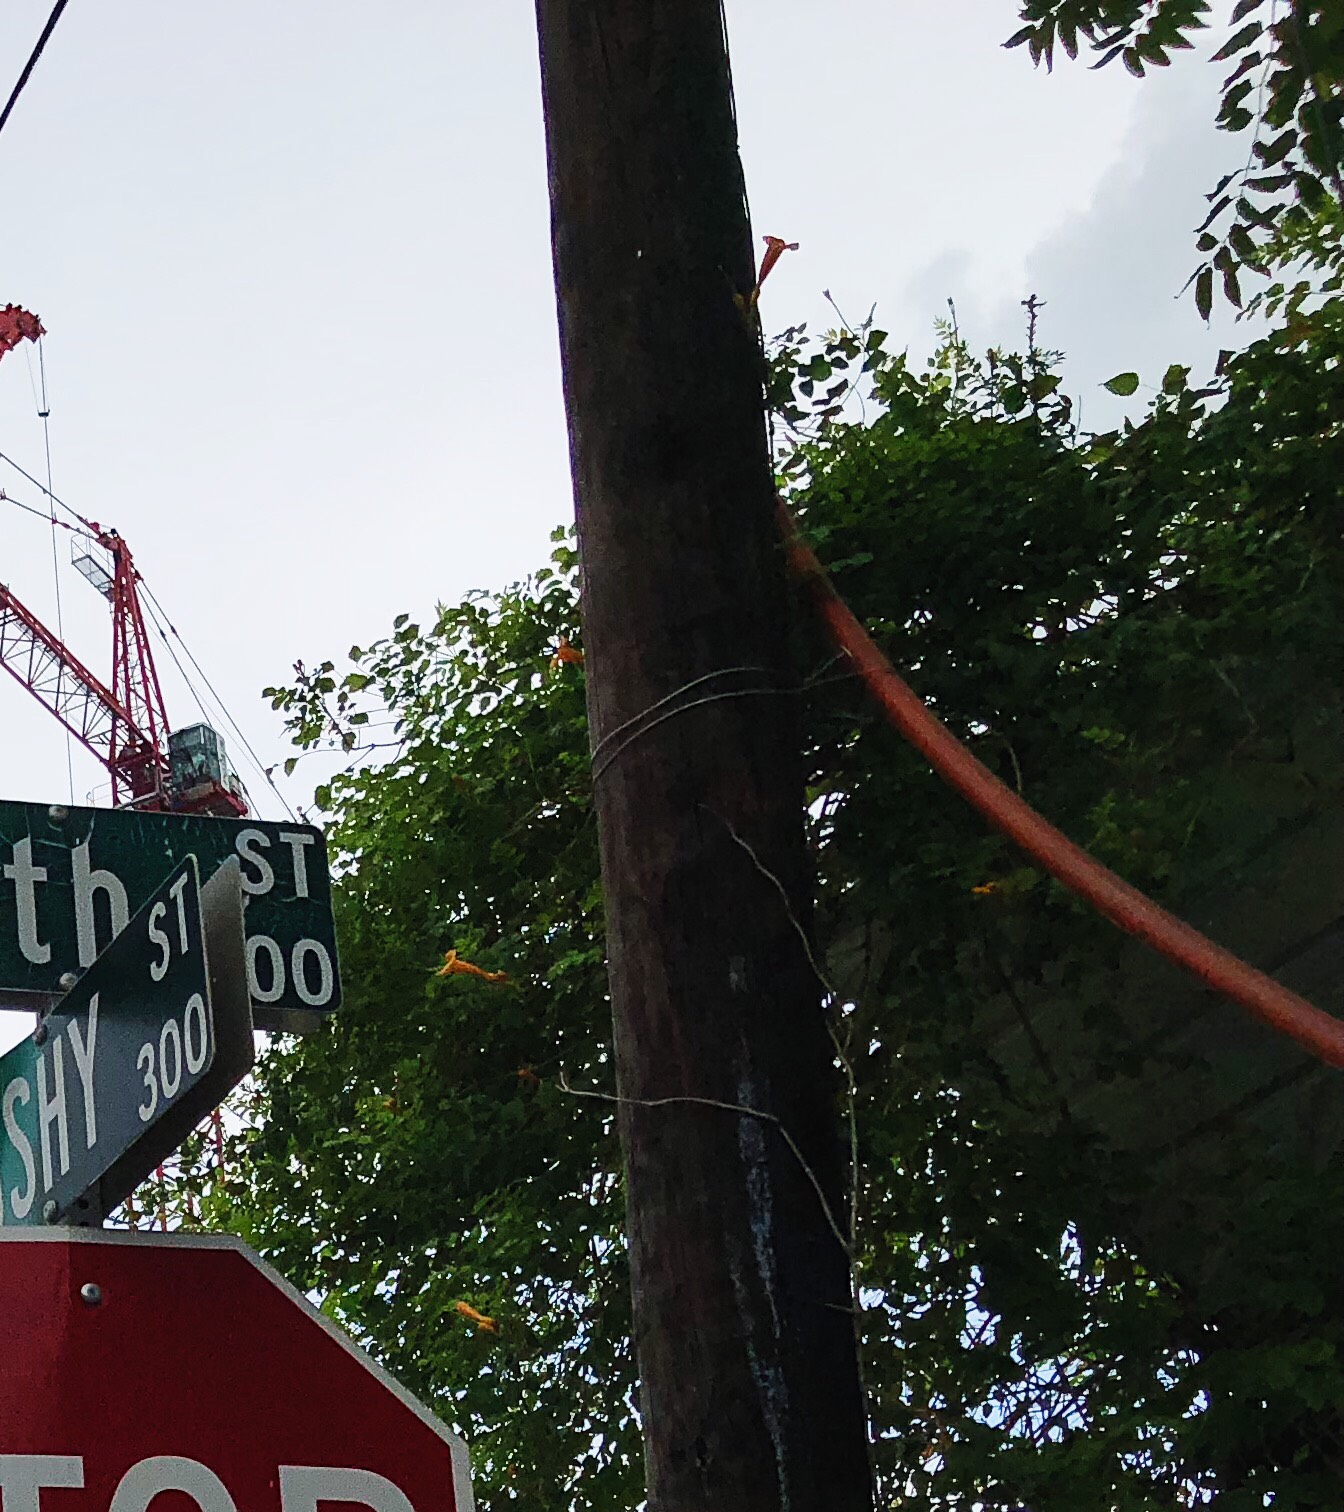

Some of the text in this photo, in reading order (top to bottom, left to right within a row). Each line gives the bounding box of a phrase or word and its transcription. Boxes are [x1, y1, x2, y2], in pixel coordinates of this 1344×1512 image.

[234, 828, 316, 898] ST
[149, 872, 191, 982] ST
[137, 993, 208, 1122] 300
